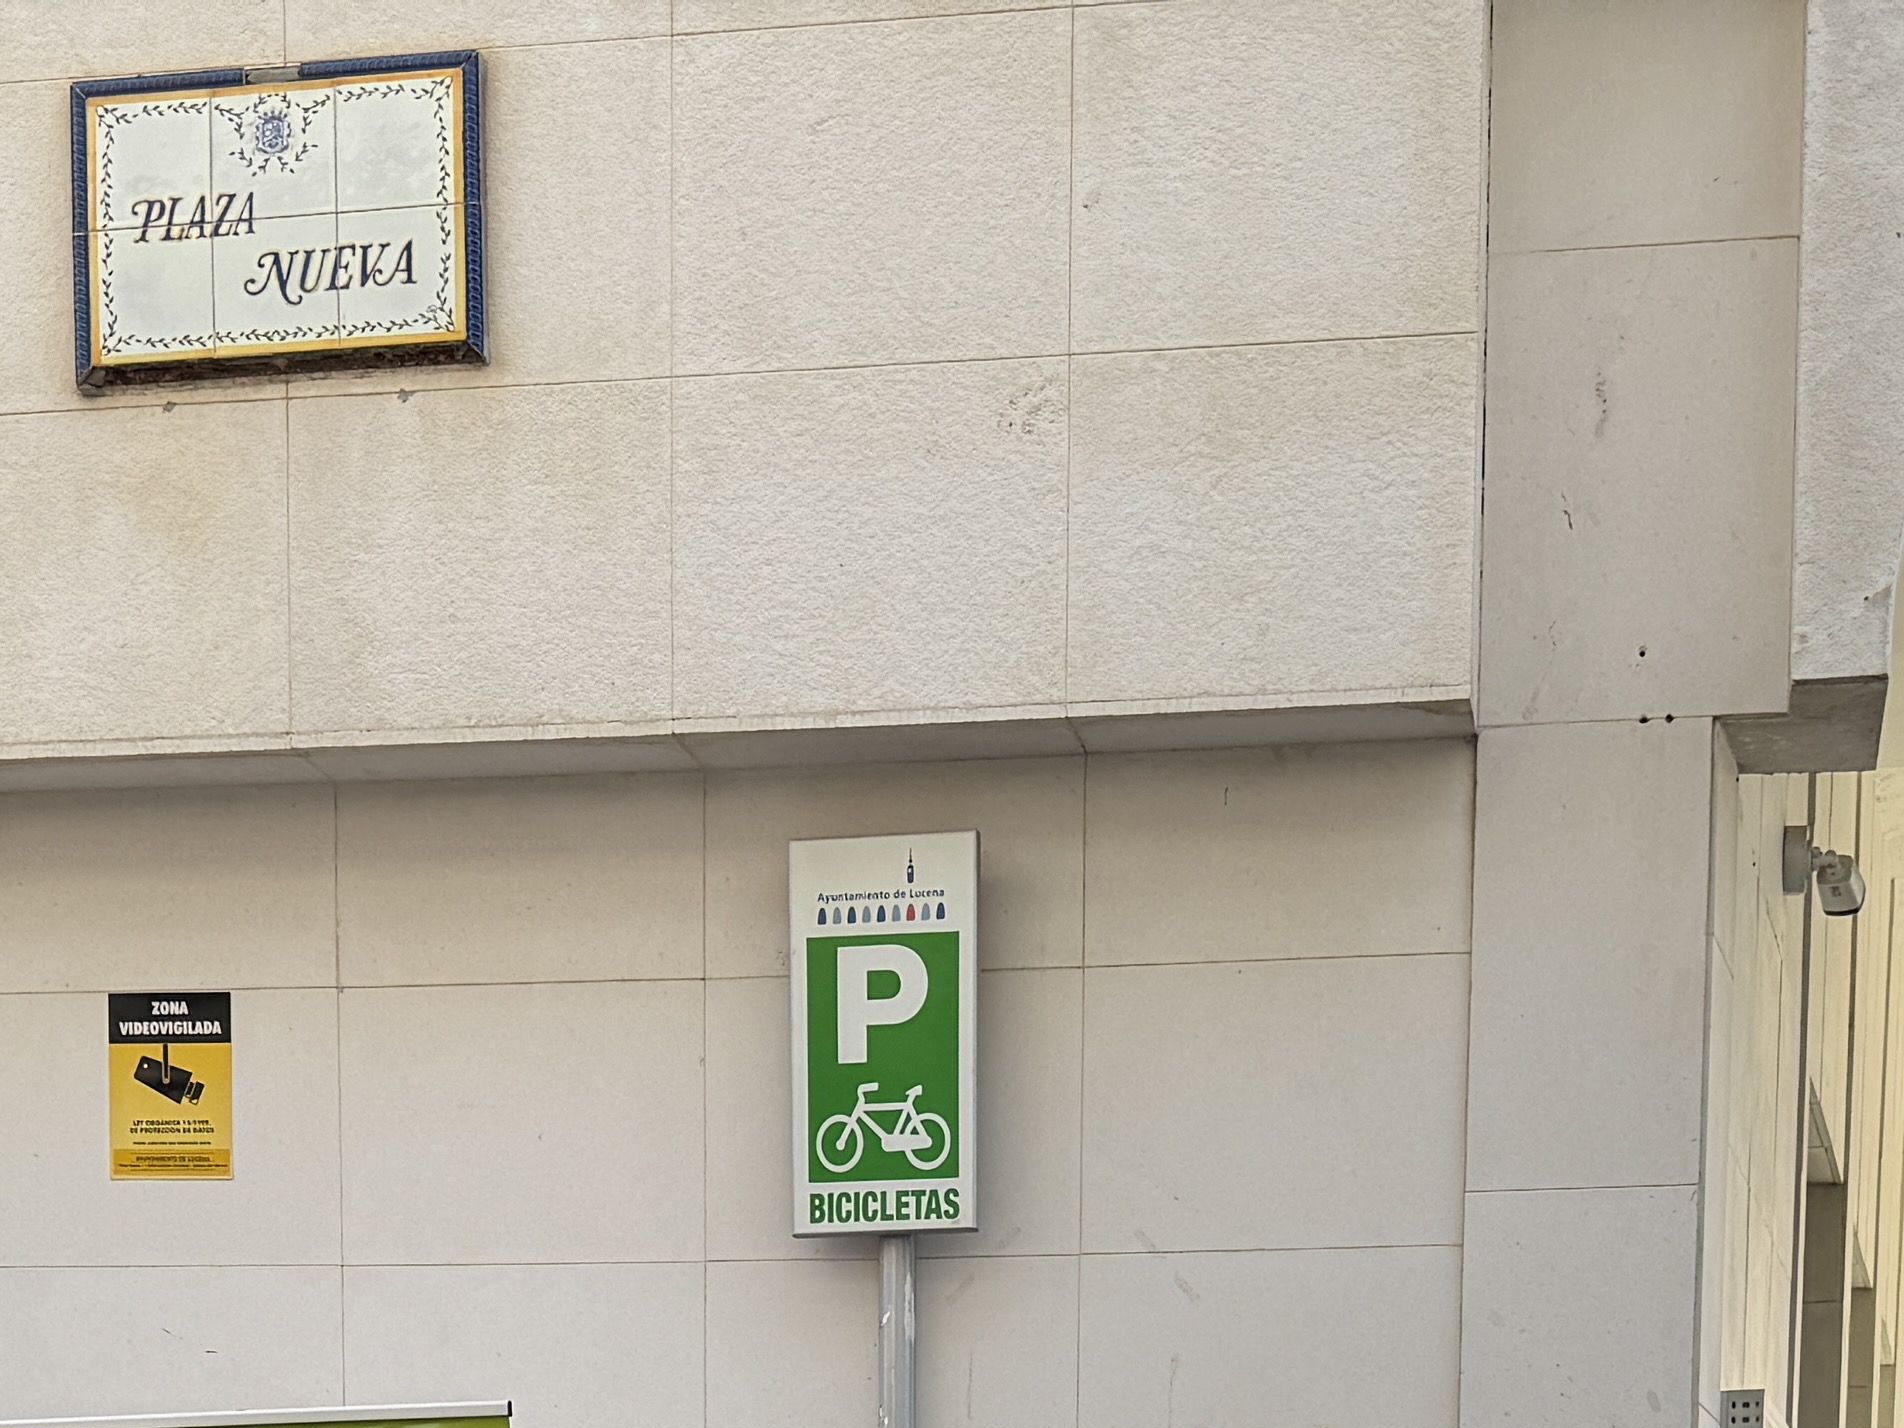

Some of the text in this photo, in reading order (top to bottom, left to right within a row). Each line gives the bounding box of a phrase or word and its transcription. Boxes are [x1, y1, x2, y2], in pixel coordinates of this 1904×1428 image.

[131, 191, 256, 244] PLAZA
[244, 240, 417, 305] NUEVA
[817, 888, 945, 904] Ayuntamiento de Lucena
[151, 1001, 189, 1015] ZONA
[837, 944, 929, 1065] P
[118, 1021, 222, 1036] VIDEOVIGILADA
[809, 1187, 960, 1225] BICICLETAS
